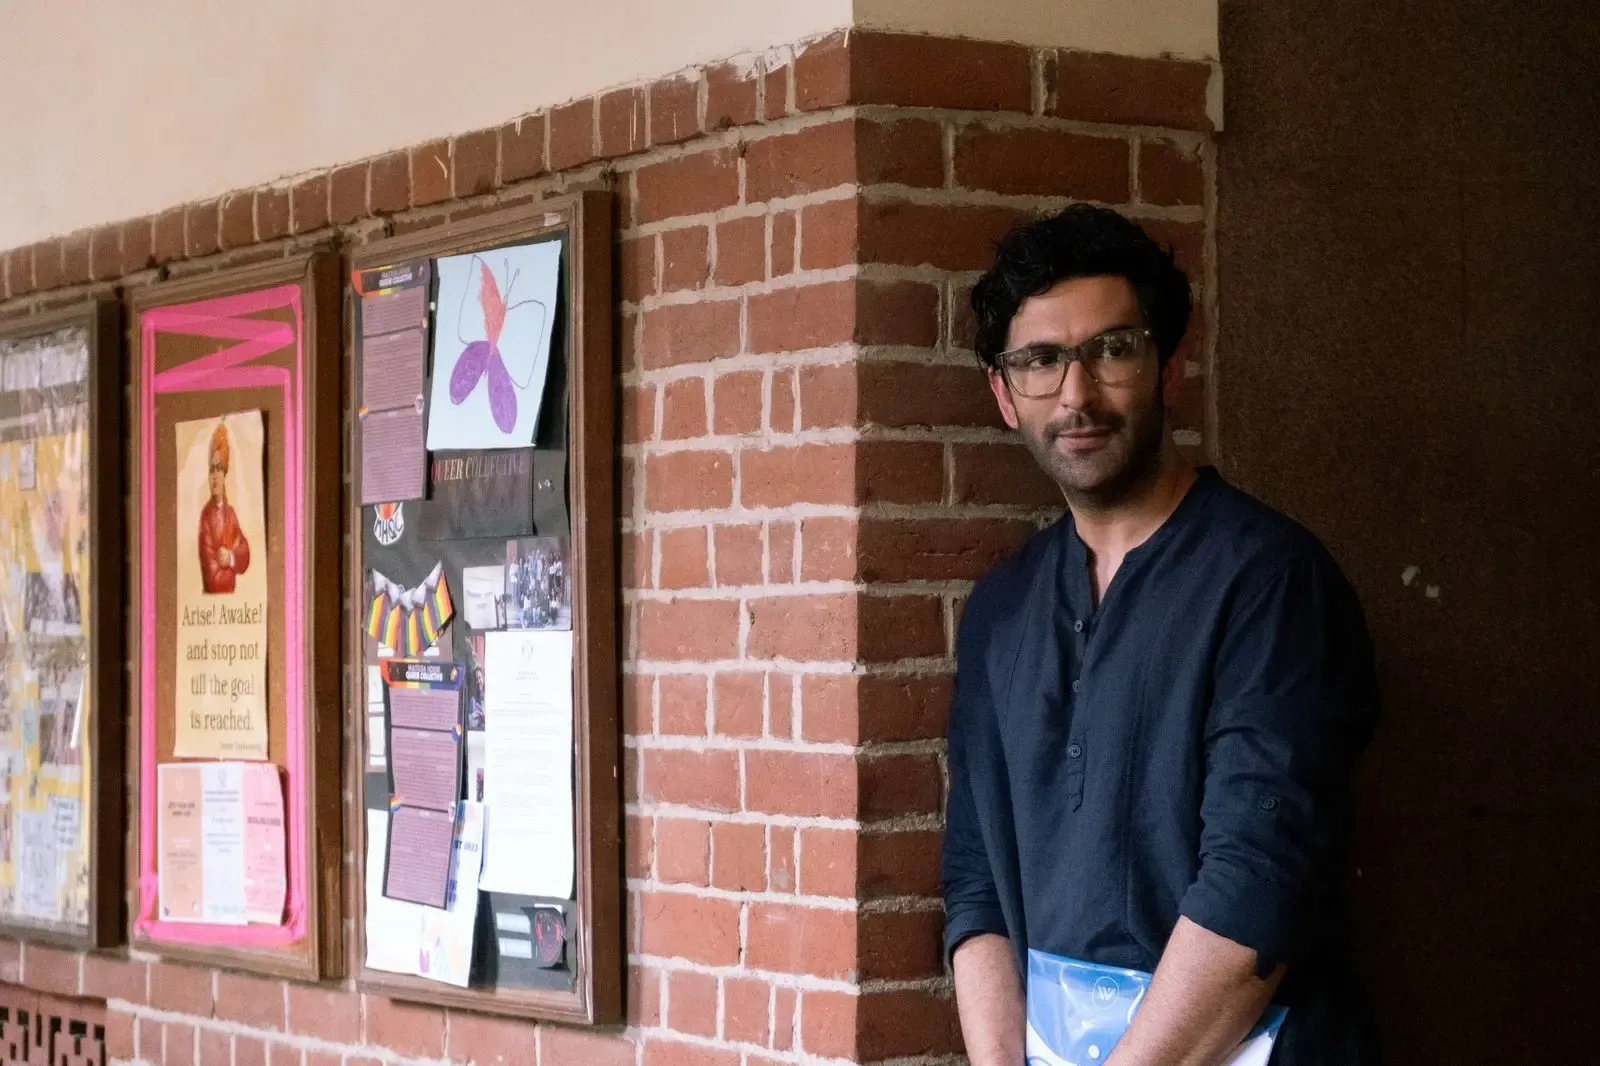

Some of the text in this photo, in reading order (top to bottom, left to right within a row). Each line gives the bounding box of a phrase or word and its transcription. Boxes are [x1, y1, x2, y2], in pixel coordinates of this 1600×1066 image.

[431, 458, 463, 481] QUEER
[182, 602, 263, 627] Arise! Awake!
[186, 639, 260, 666] and stop not
[190, 672, 255, 702] till the goal
[190, 708, 254, 731] is reached.
